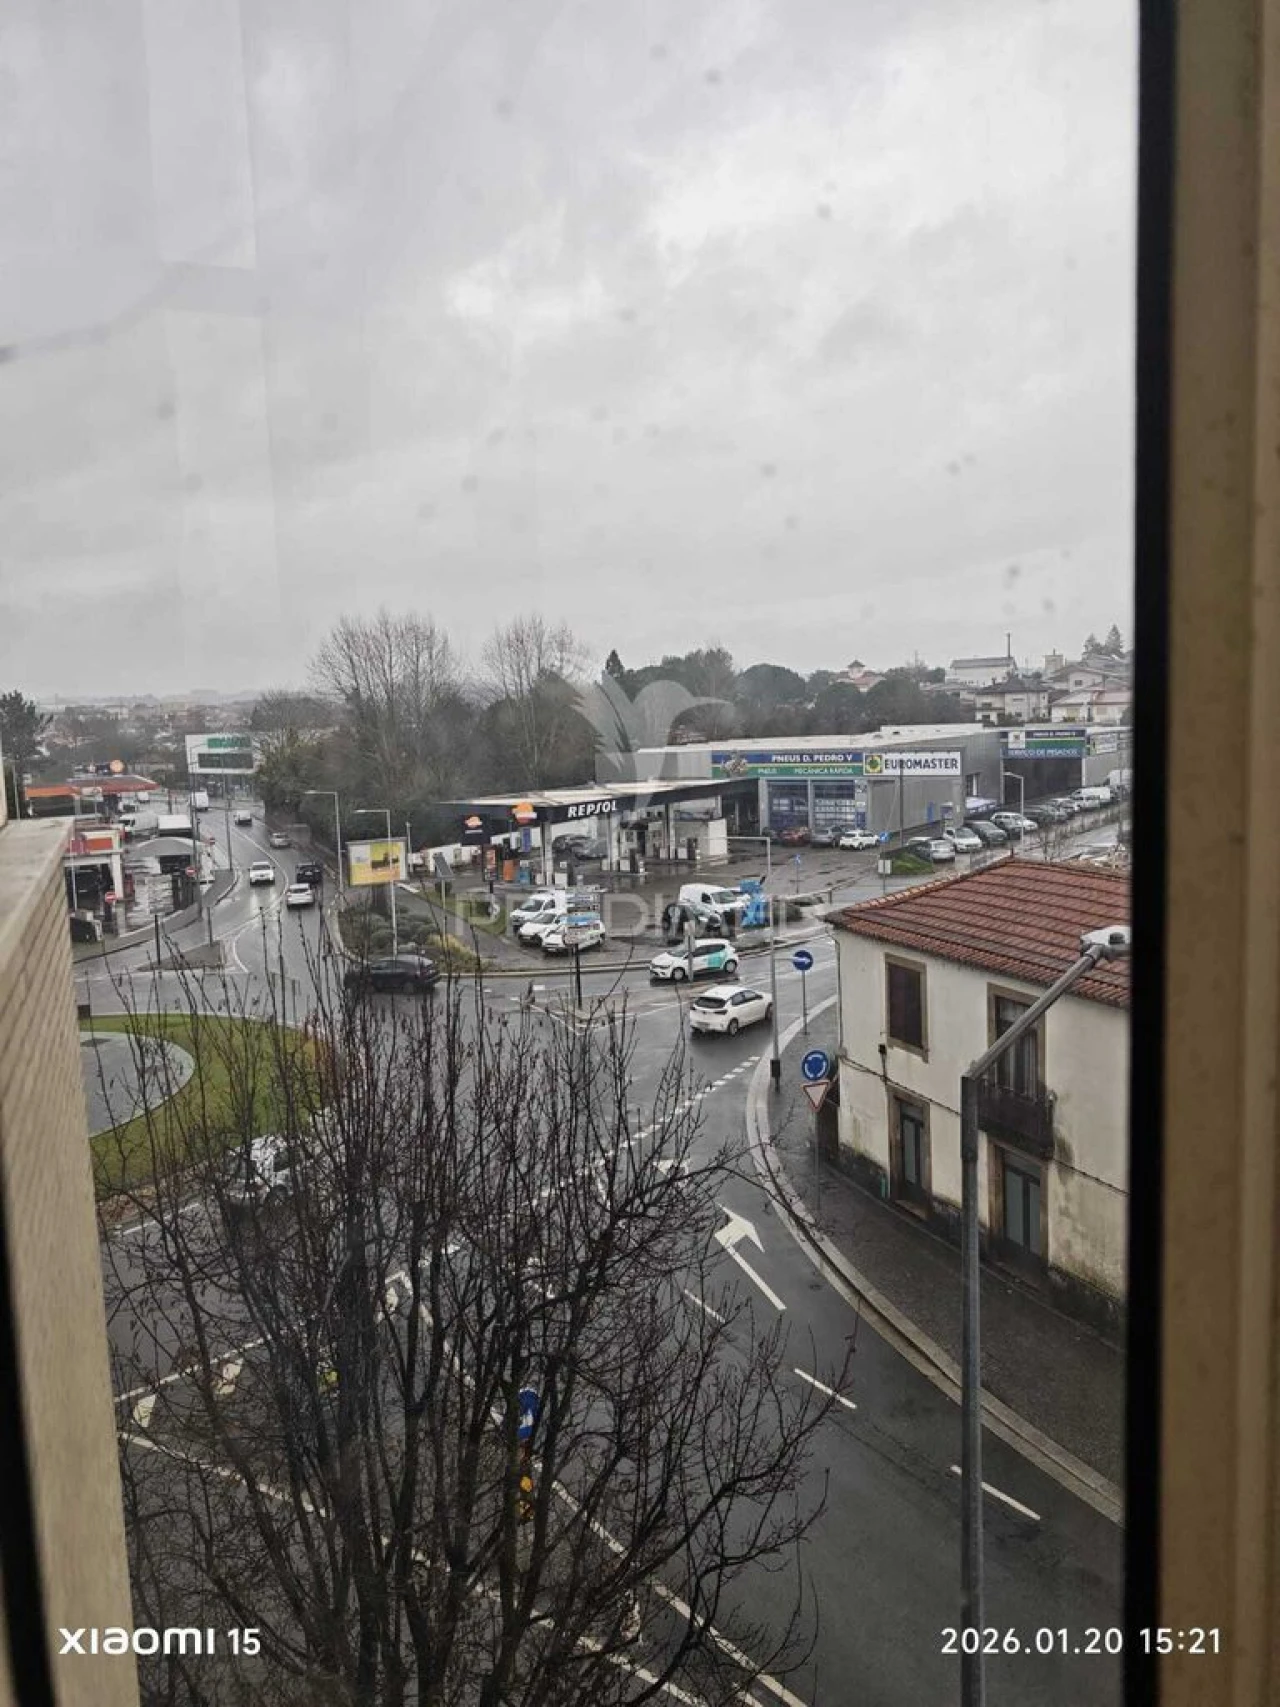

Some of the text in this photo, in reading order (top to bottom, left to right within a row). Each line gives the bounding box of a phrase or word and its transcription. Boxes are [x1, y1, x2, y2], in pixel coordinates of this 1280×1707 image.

[772, 754, 853, 763] PNEUS D. PEDRO V
[884, 757, 959, 769] EUROMASTER
[567, 799, 618, 818] REPSOL
